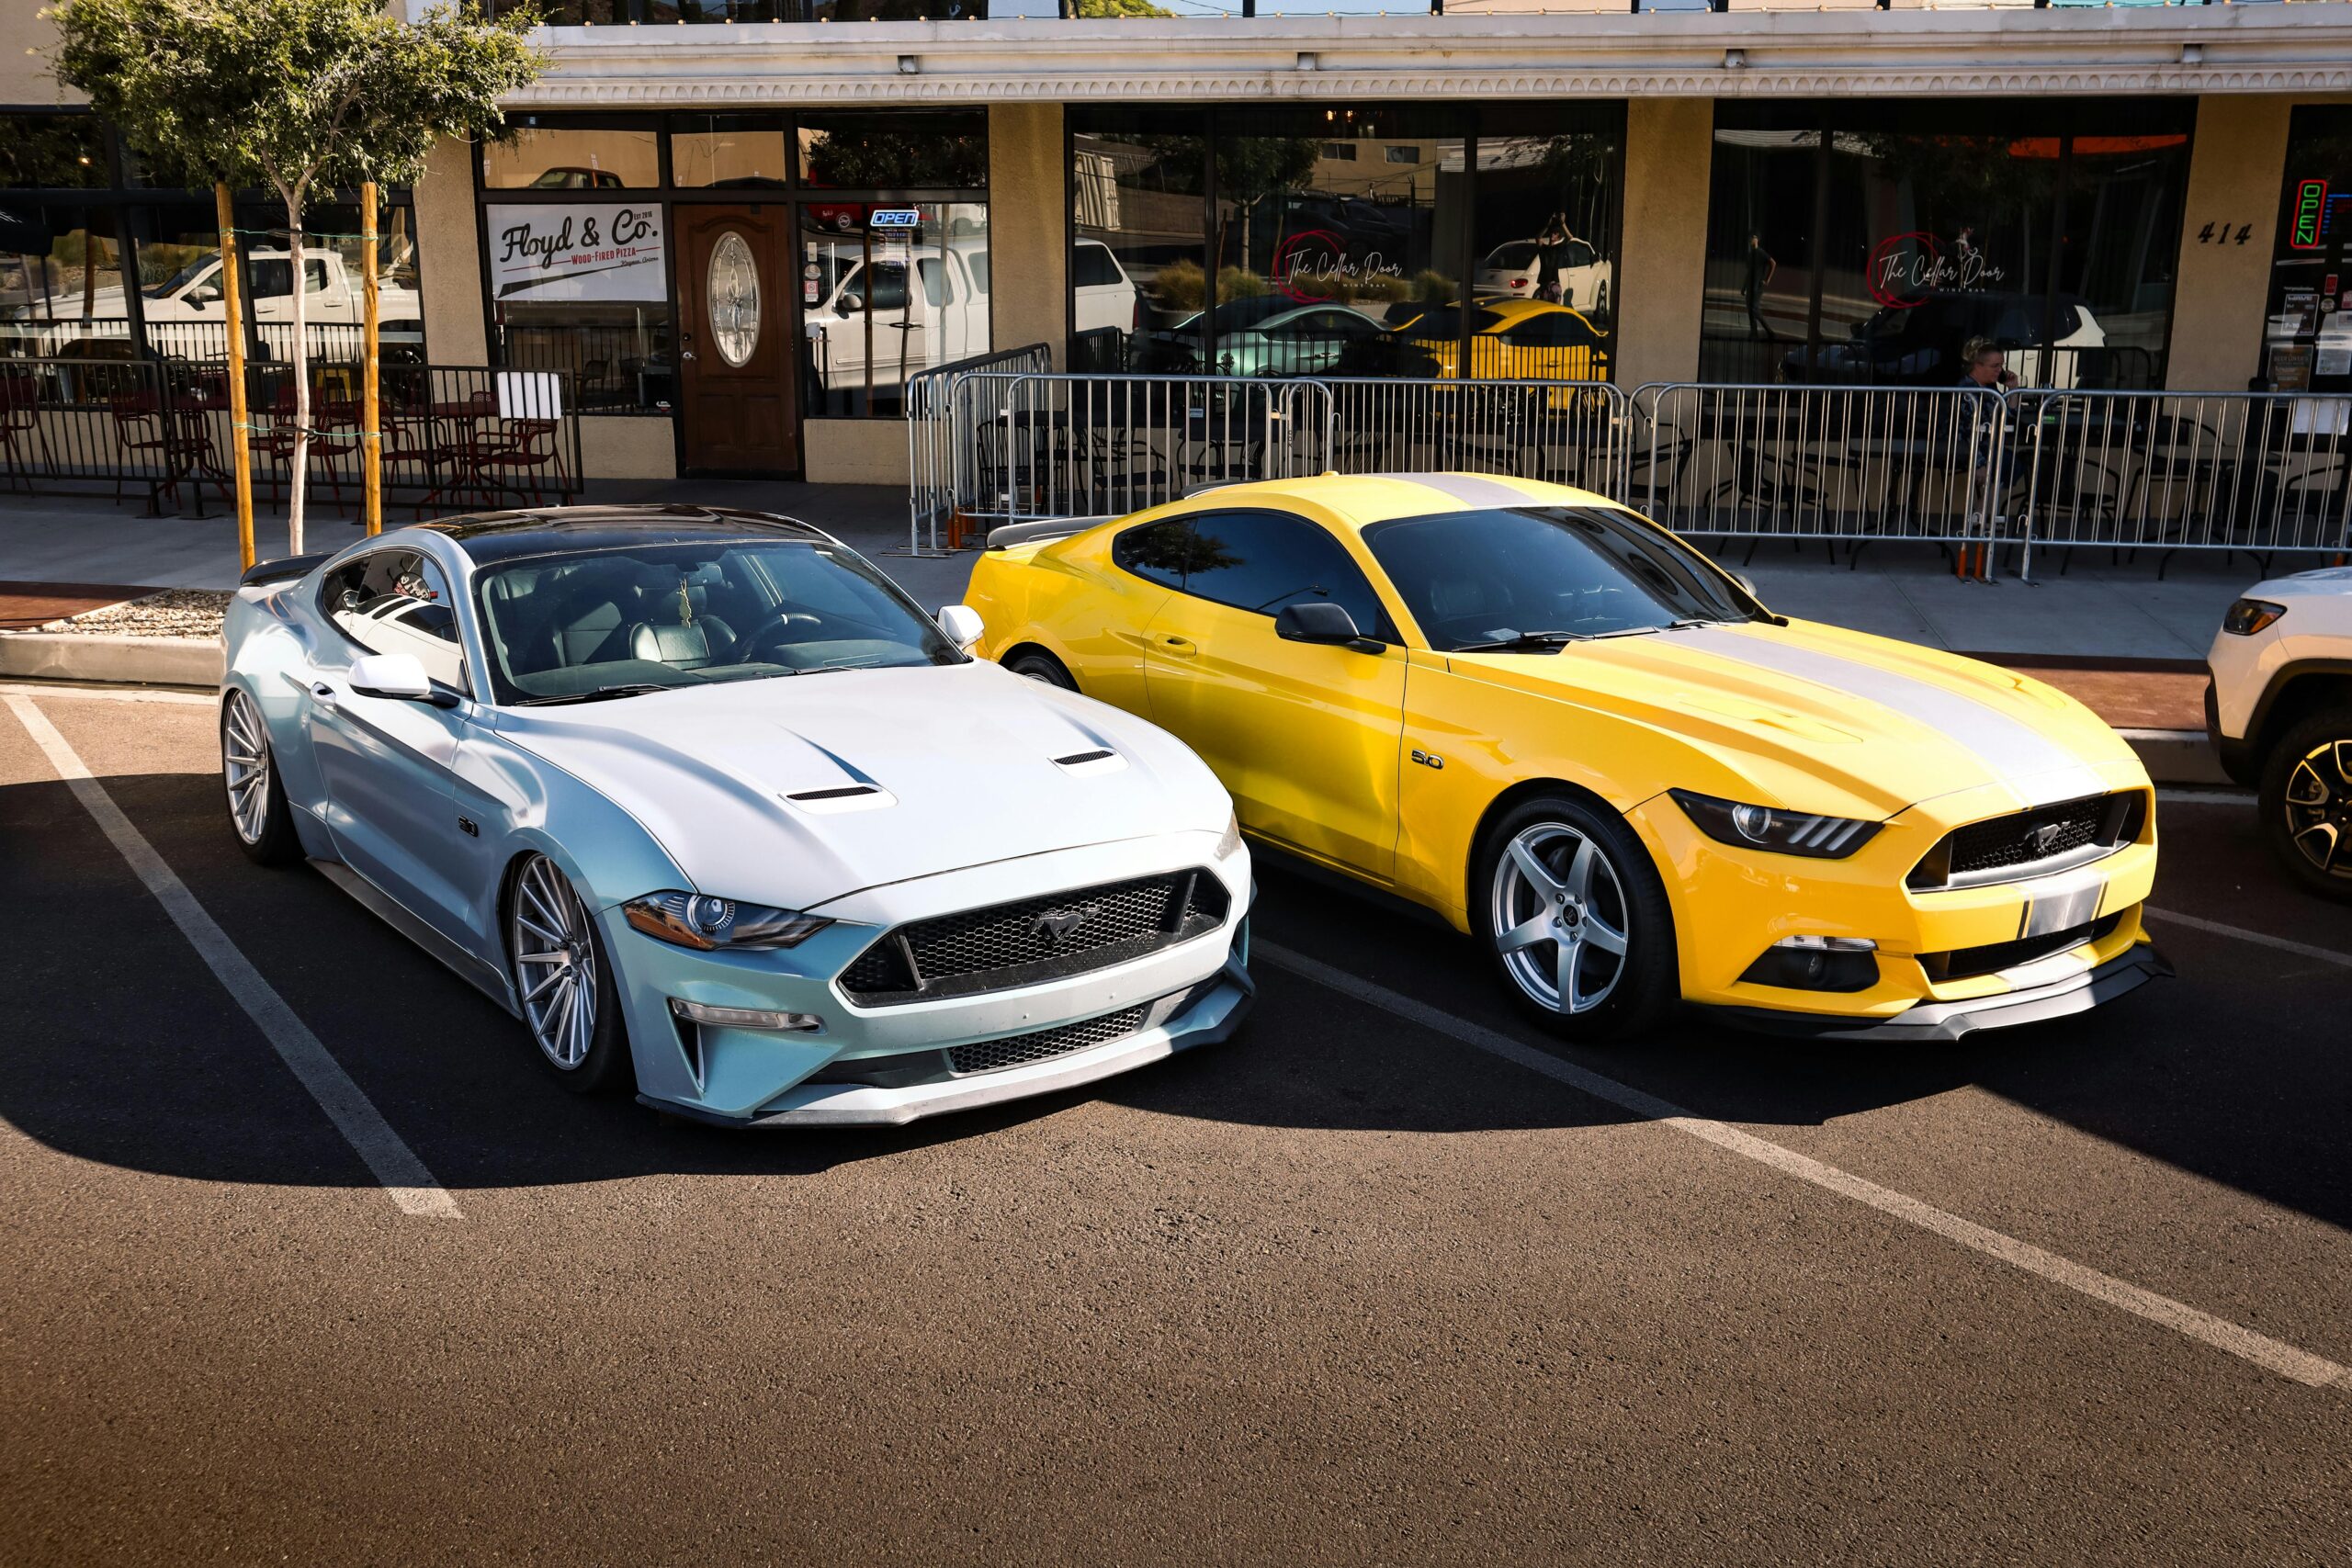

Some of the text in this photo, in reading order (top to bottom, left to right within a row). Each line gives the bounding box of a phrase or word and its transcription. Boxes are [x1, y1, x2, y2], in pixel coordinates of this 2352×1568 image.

[874, 212, 916, 224] OPEN
[2296, 185, 2321, 244] OPEN
[499, 209, 658, 269] Floyd & Co.
[2198, 221, 2252, 245] 414
[616, 247, 637, 258] PIZZA
[1285, 248, 1402, 285] The Cellar Door
[1879, 251, 2005, 289] The Cellar Door
[1411, 749, 1443, 770] 5.0
